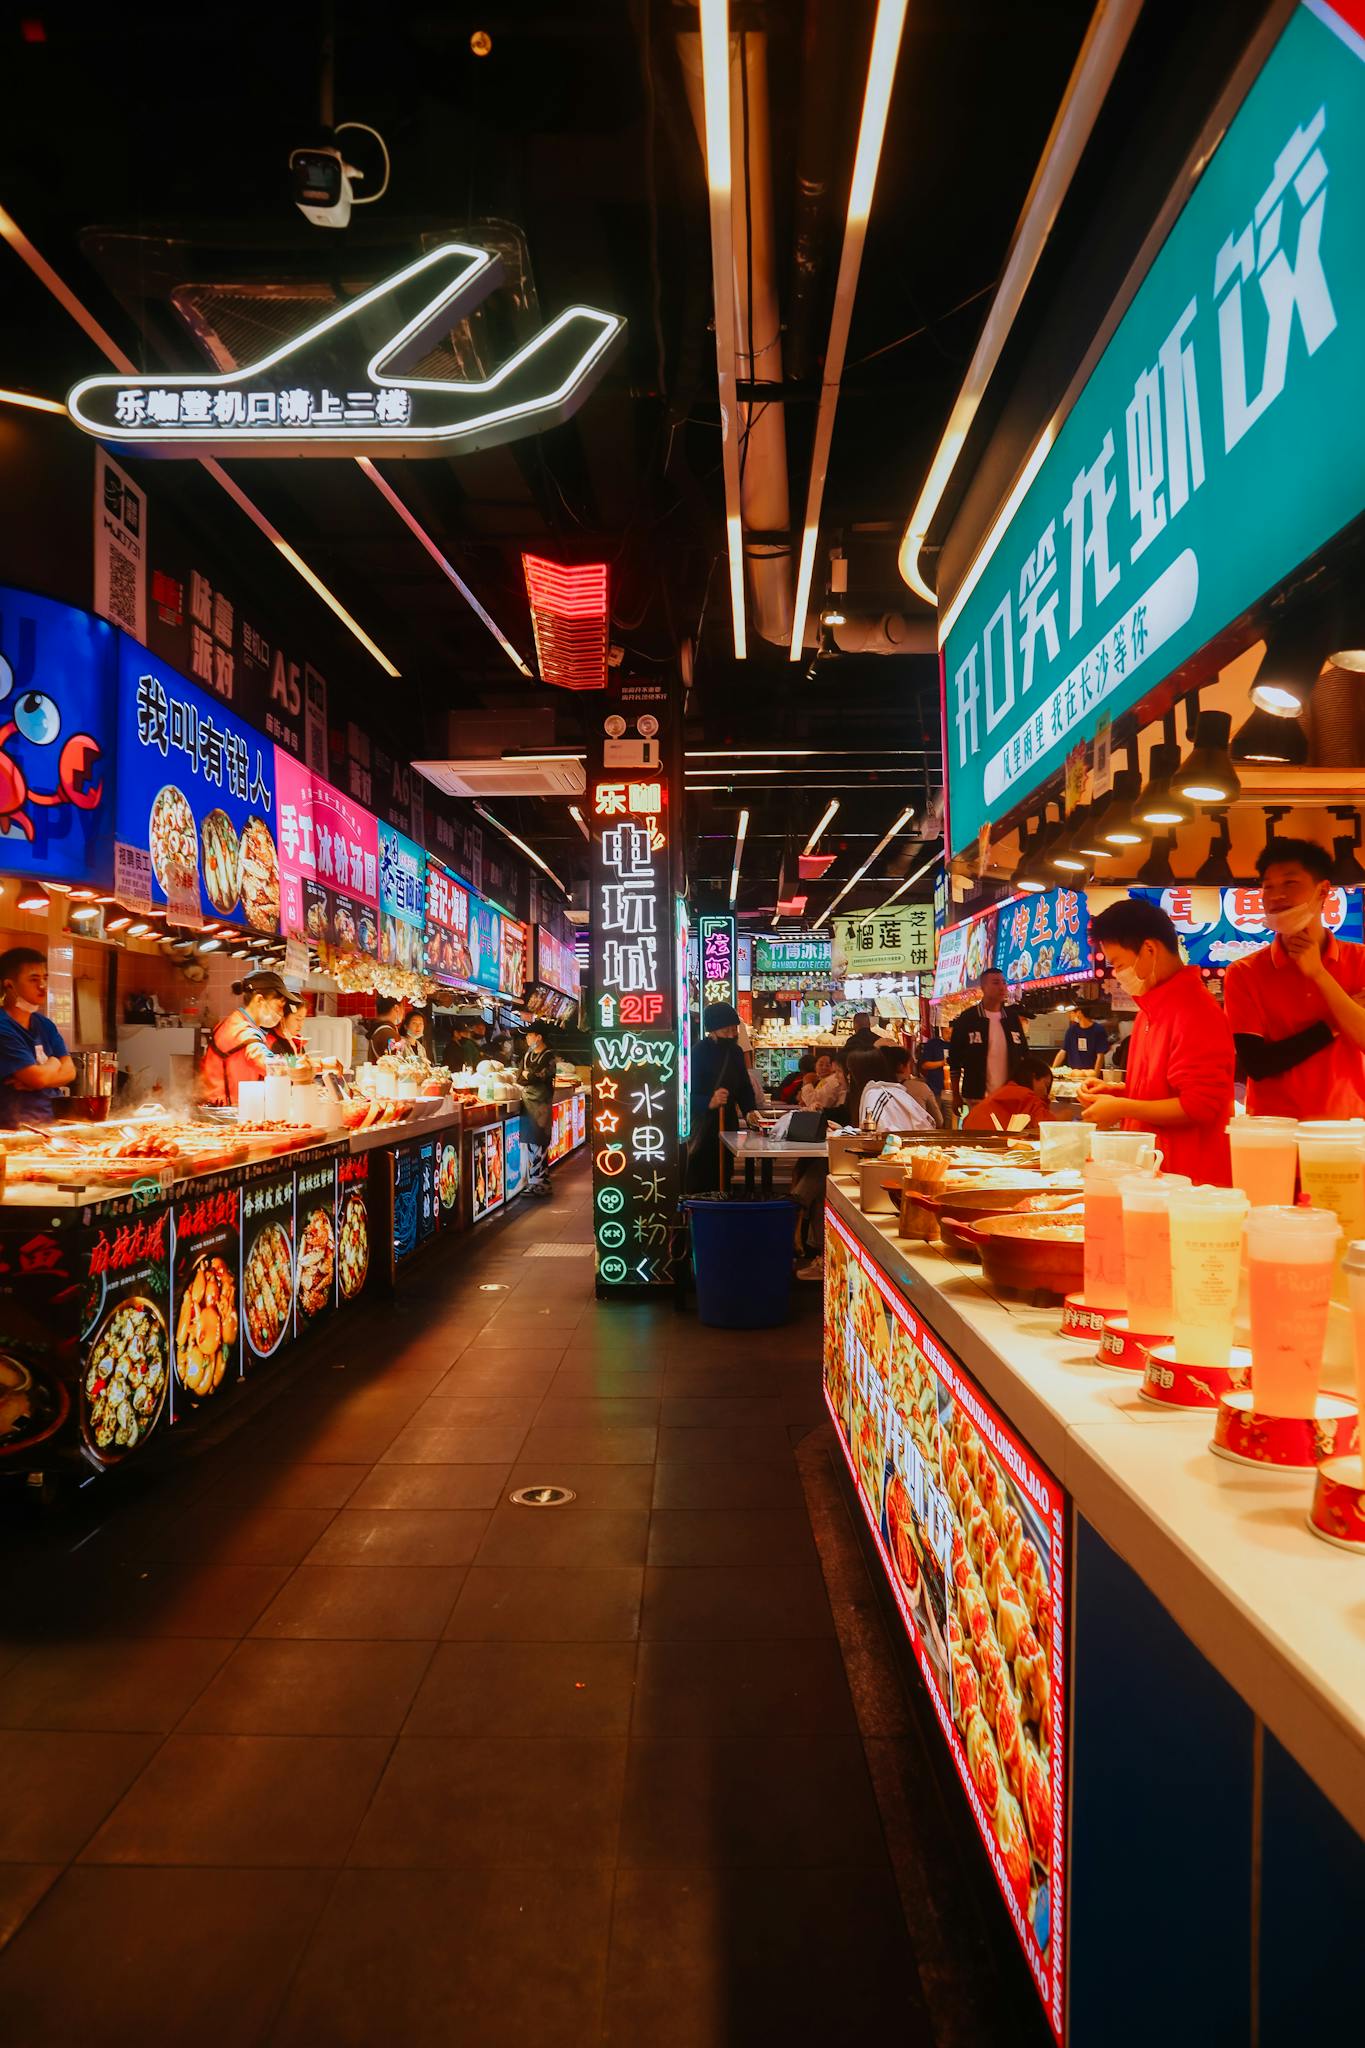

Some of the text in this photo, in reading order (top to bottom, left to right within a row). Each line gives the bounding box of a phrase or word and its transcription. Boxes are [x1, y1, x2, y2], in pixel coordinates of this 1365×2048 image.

[115, 389, 411, 425] 乐咖登机口请上二楼
[955, 104, 1338, 768] 开口笑龙虾饺
[272, 650, 301, 716] A5
[1050, 605, 1149, 737] 我在长沙等你
[280, 803, 377, 899] 手工冰粉汤圆
[601, 822, 658, 992] 电玩城
[910, 910, 929, 965] 芝士饼
[1009, 887, 1081, 954] 烤生蚝
[619, 993, 664, 1024] 2F
[630, 1082, 668, 1246] 水果冰粉
[243, 1181, 294, 1218] 香辣皮皮虾
[0, 1233, 70, 1279] 鱼
